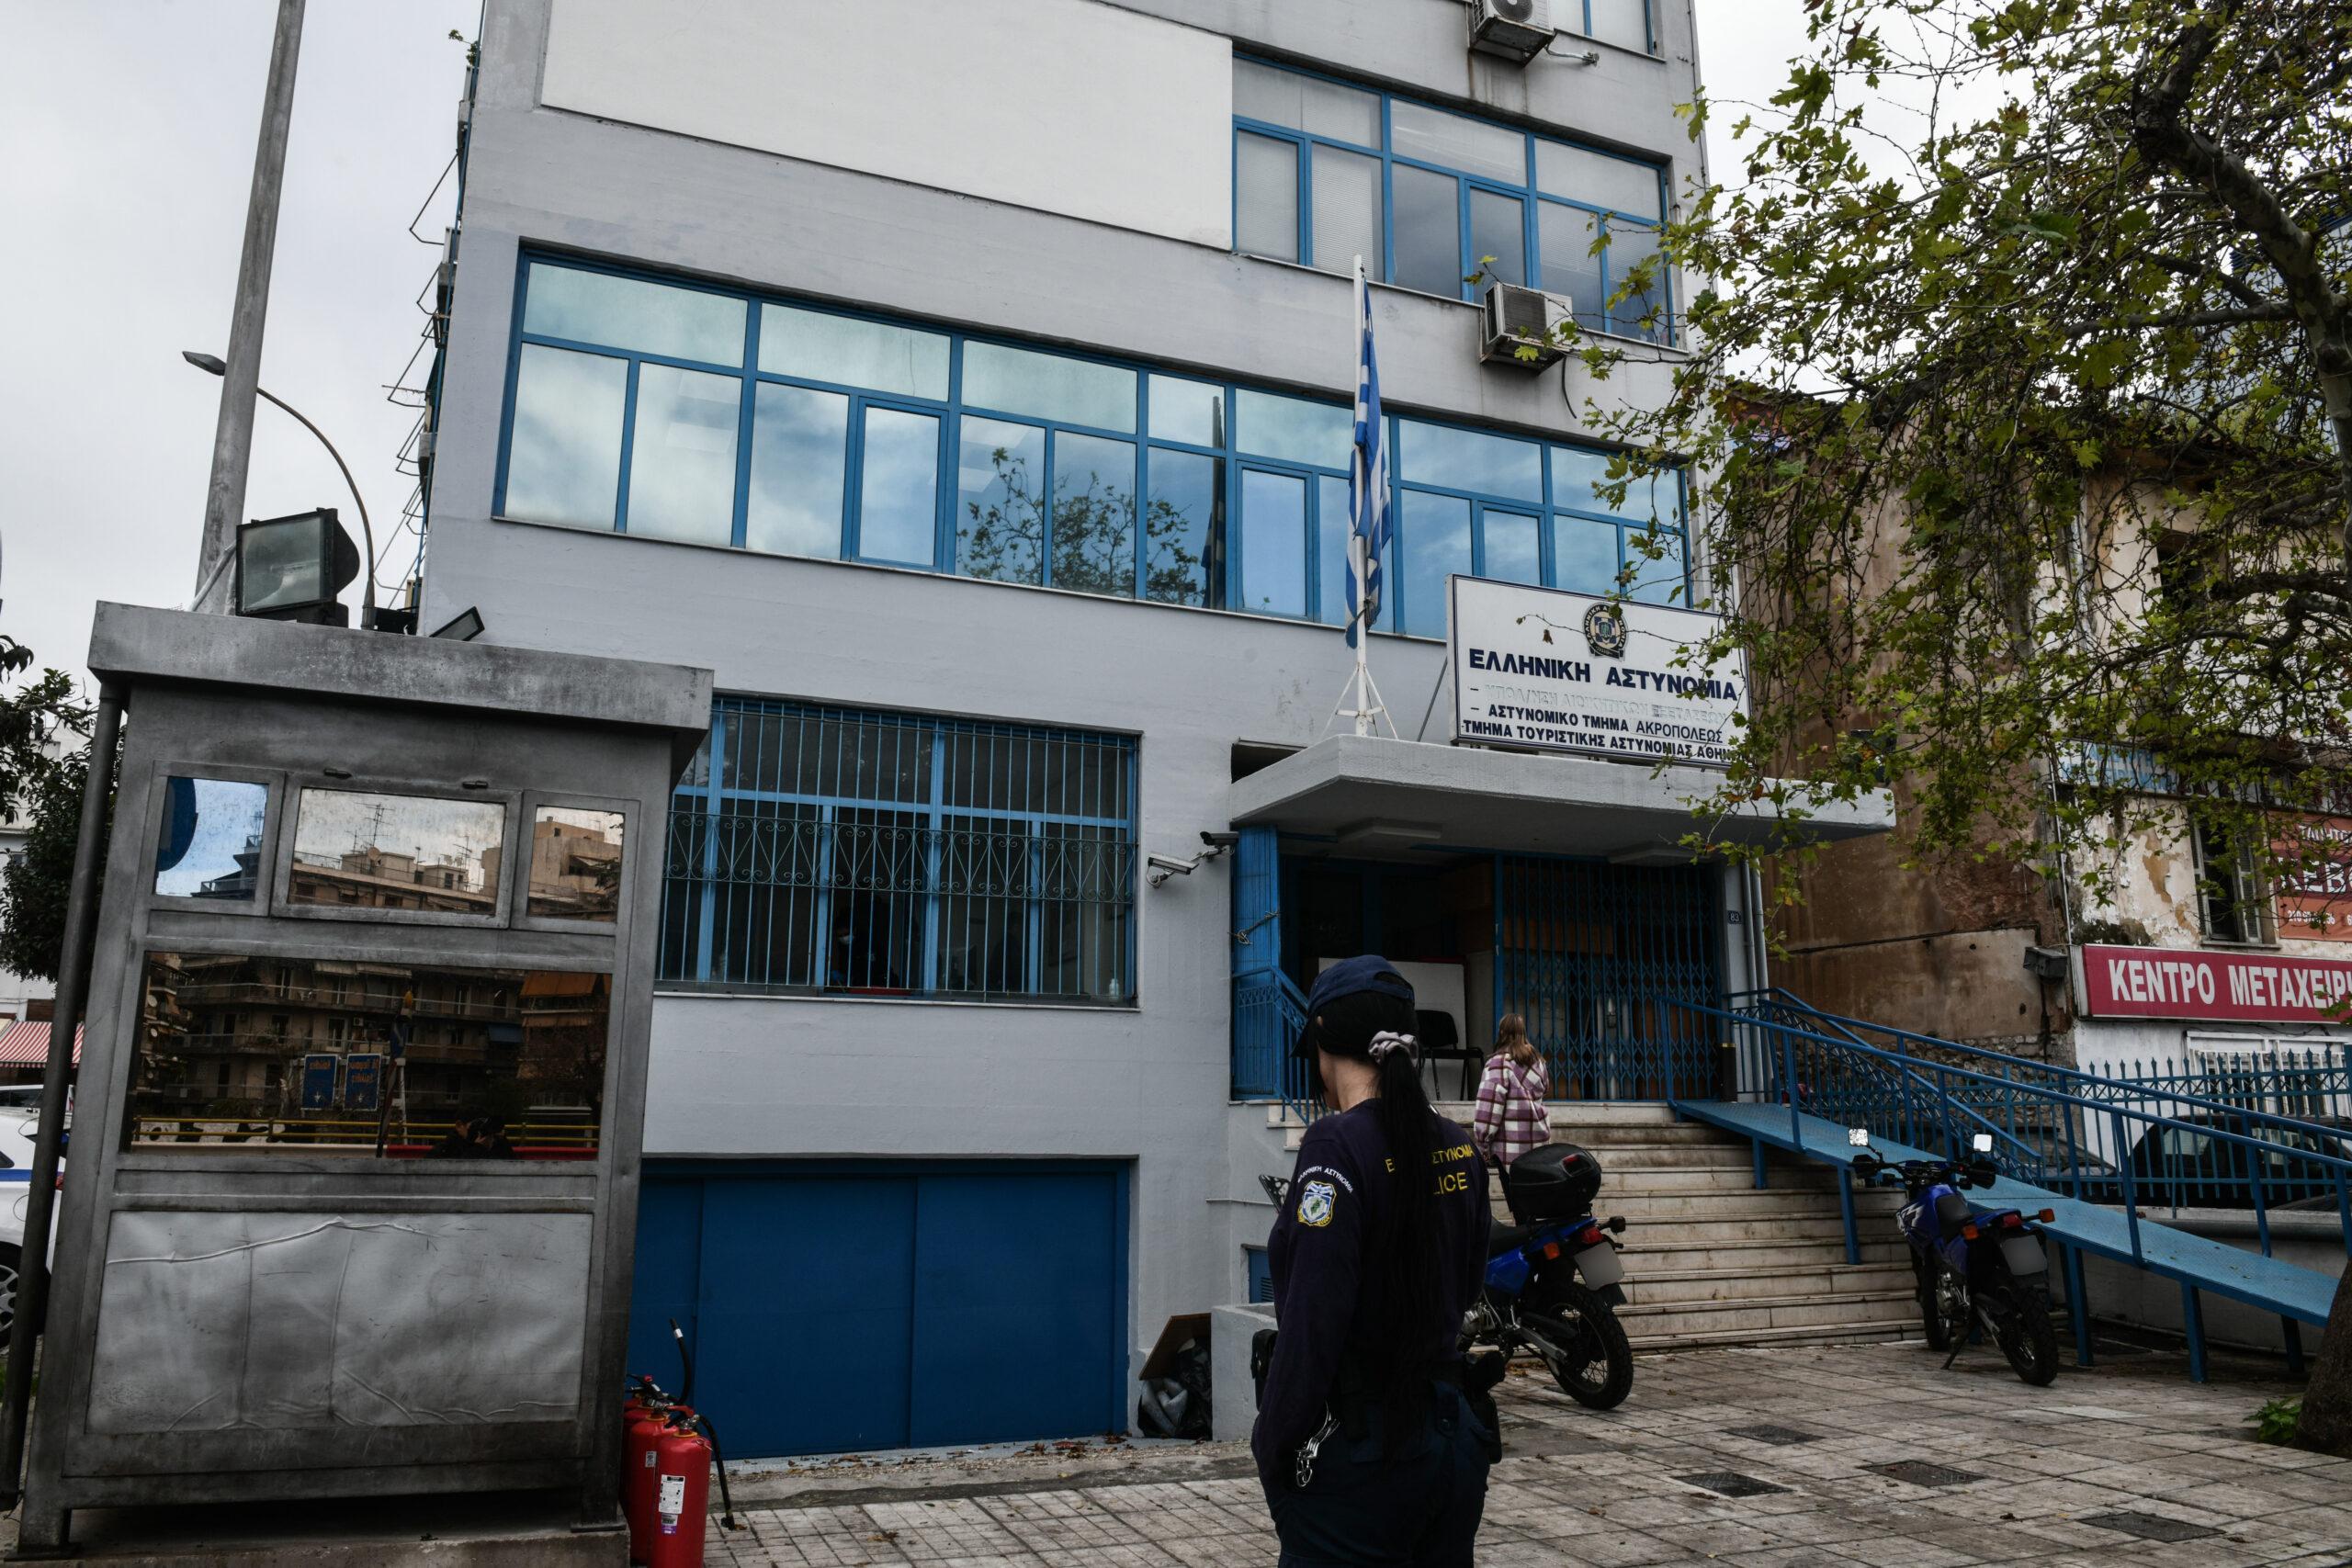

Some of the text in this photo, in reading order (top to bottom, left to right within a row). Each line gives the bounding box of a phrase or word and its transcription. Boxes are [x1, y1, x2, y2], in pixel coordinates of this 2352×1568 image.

[1469, 648, 1738, 701] ΕΛΛΗΝΙΚΗ ΑΣΤΥΝΟΜΙΑ
[1488, 704, 1724, 743] ΑΣΤΥΝΟΜΙΚΟ ΤΜΗΜΑ ΑΚΡΟΠΟΛΕΩΣ
[1517, 725, 1606, 748] ΤΟΥΡΙΣΤΙΚΗΣ
[1697, 746, 1733, 761] ΑΘΗΝ
[2109, 959, 2215, 1005] ΚΕΝΤΡΟ
[1432, 1144, 1475, 1165] ΣΤΥΝΟΜΙΑ
